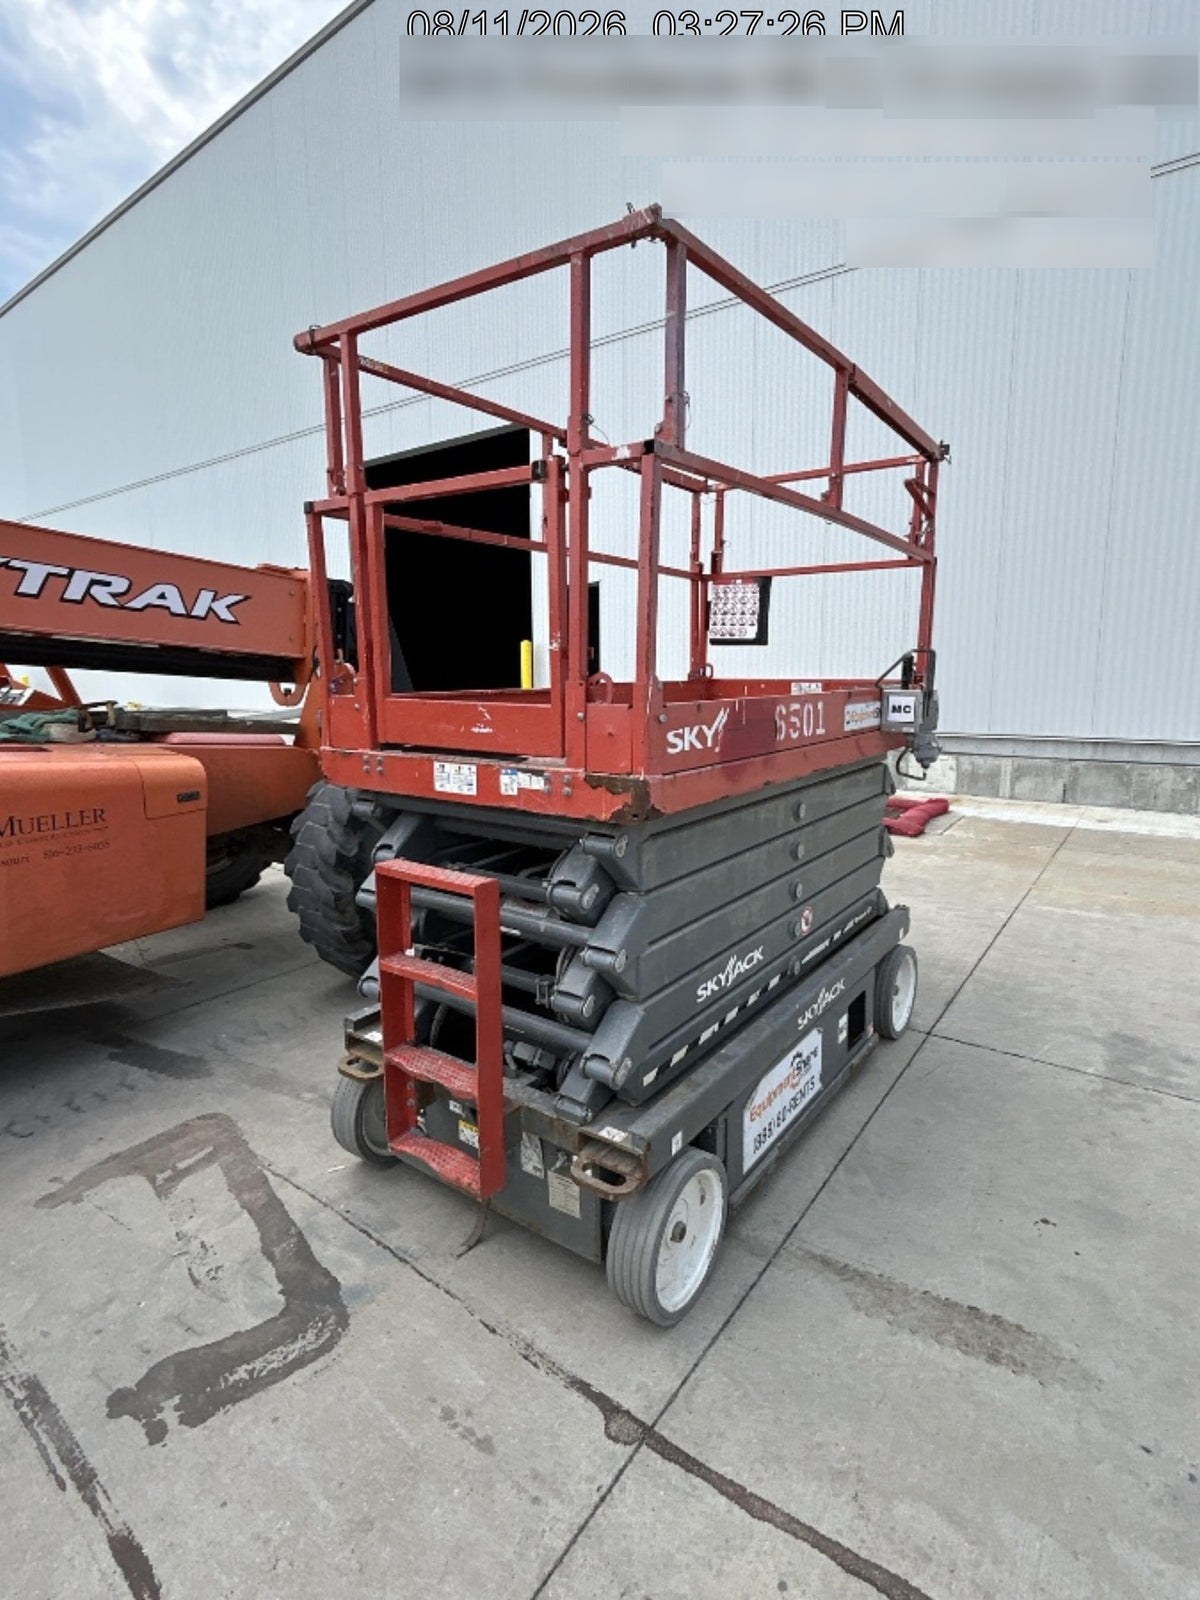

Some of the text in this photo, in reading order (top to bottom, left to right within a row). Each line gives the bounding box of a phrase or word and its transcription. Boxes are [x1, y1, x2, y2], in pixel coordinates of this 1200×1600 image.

[0, 556, 251, 625] TRAK
[891, 704, 912, 714] MC
[696, 945, 764, 1003] SKYJACK
[797, 977, 846, 1030] SKYJACK
